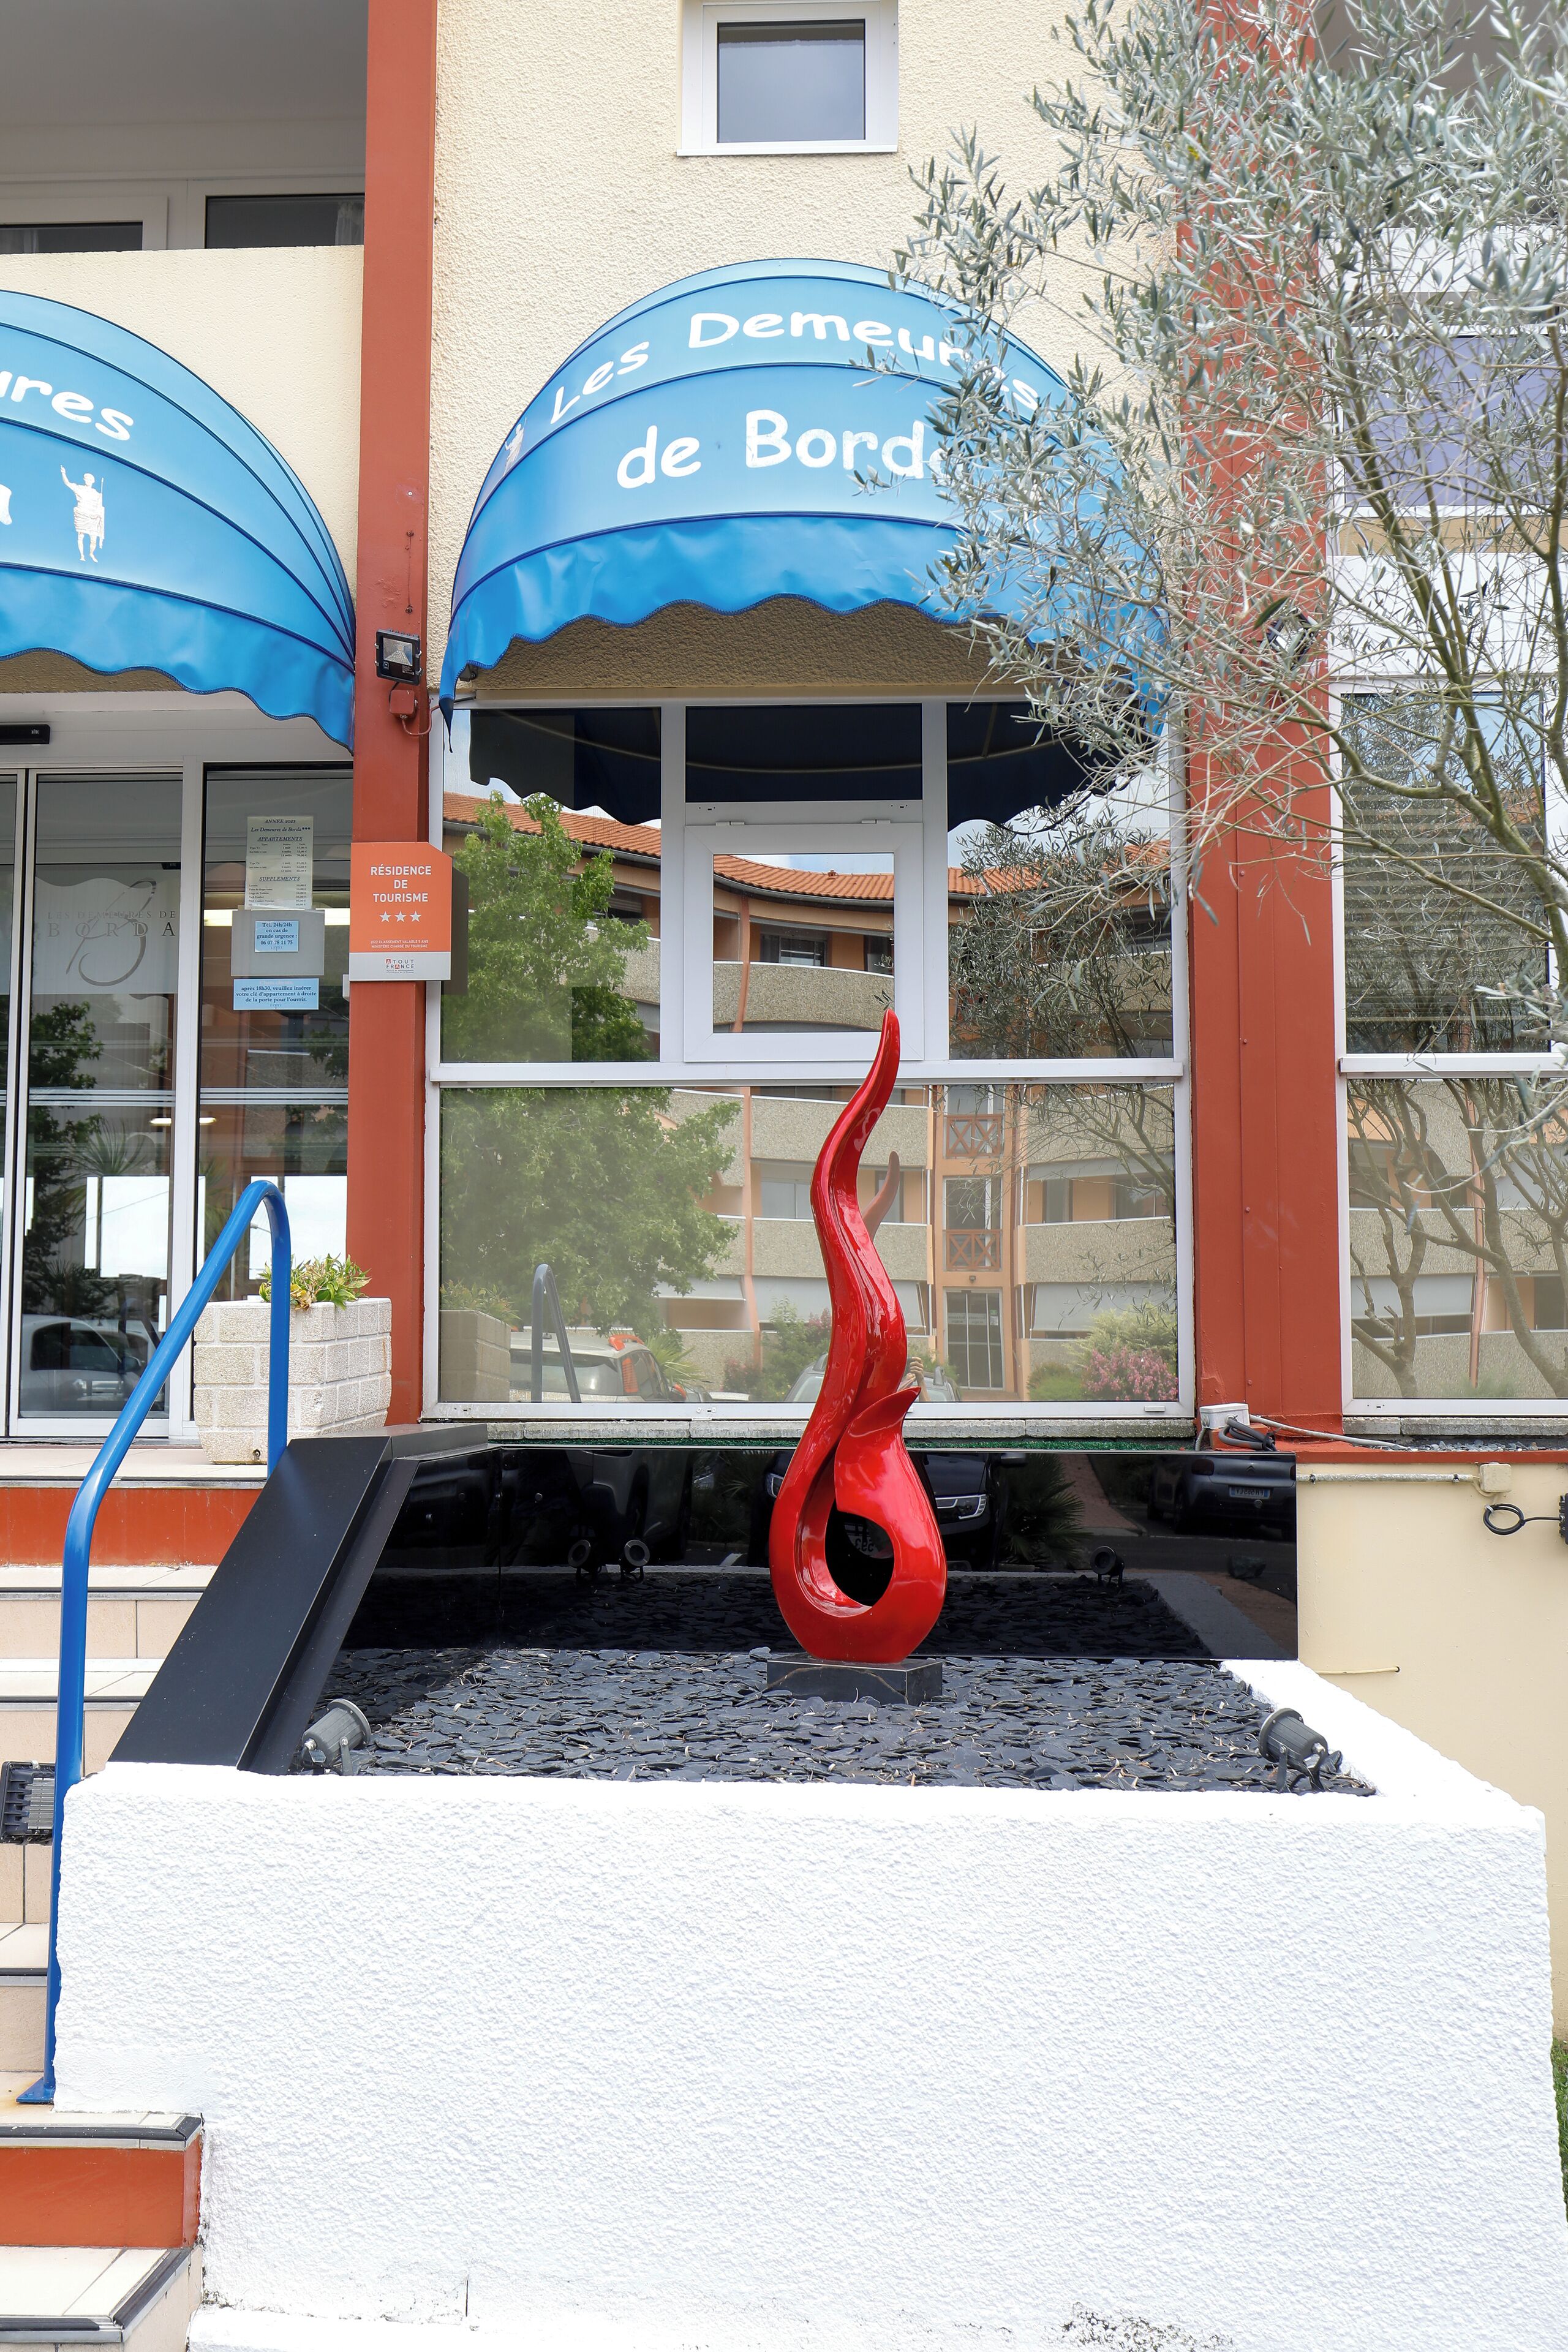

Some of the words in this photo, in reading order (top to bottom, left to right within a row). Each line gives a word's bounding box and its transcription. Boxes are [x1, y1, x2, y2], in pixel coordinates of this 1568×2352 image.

[550, 341, 650, 424] Les
[616, 425, 702, 489] de
[370, 864, 432, 875] RÉSIDENCE
[394, 880, 408, 889] DE
[372, 893, 428, 902] TOURISME
[48, 922, 176, 937] BORDA
